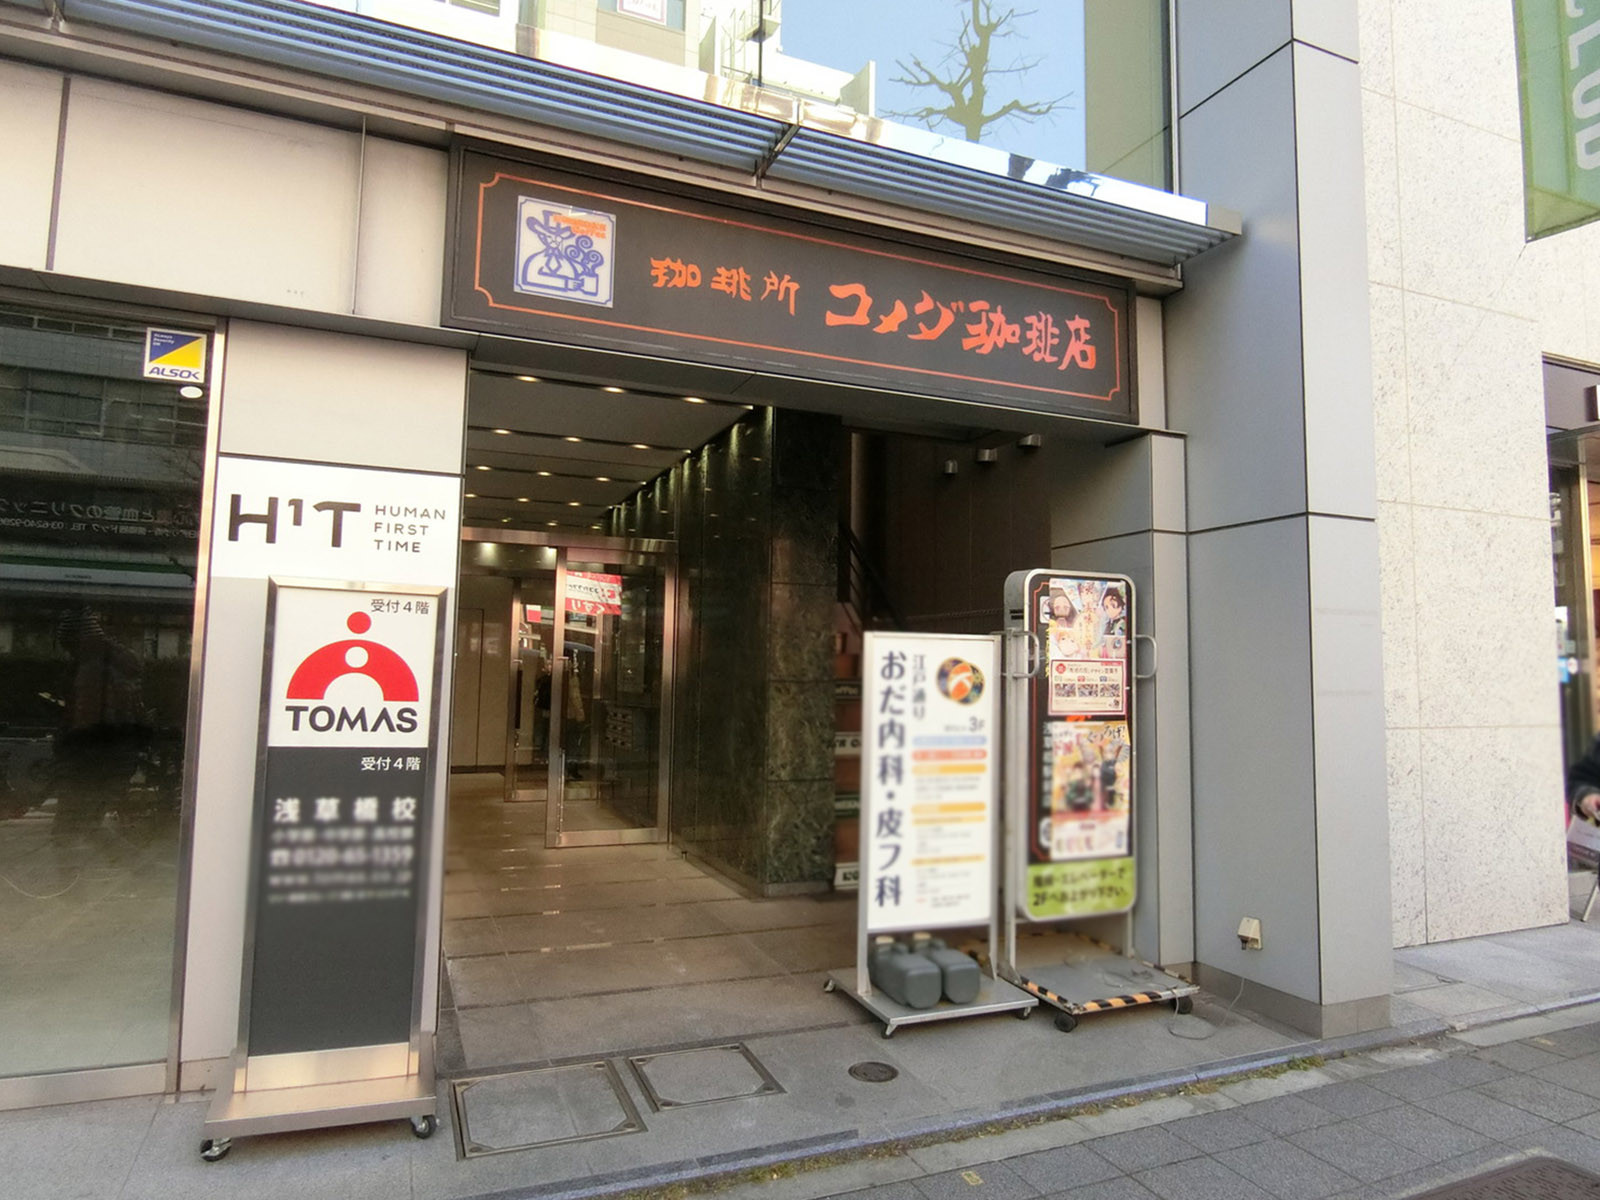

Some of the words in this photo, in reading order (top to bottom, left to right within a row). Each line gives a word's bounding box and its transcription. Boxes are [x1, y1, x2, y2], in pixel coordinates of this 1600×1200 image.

[650, 257, 800, 316] 珈琲所
[824, 283, 1097, 371] コメダ珈琲店
[149, 366, 200, 380] ALSOK
[375, 504, 446, 520] HUMAN
[374, 522, 429, 536] FIRST
[373, 539, 421, 553] TIME
[371, 599, 430, 614] 受付4階
[912, 653, 927, 720] 江戸通り
[285, 706, 418, 733] TOMAS
[361, 756, 421, 771] 受付4階
[875, 650, 907, 908] おだ内科・皮フ科
